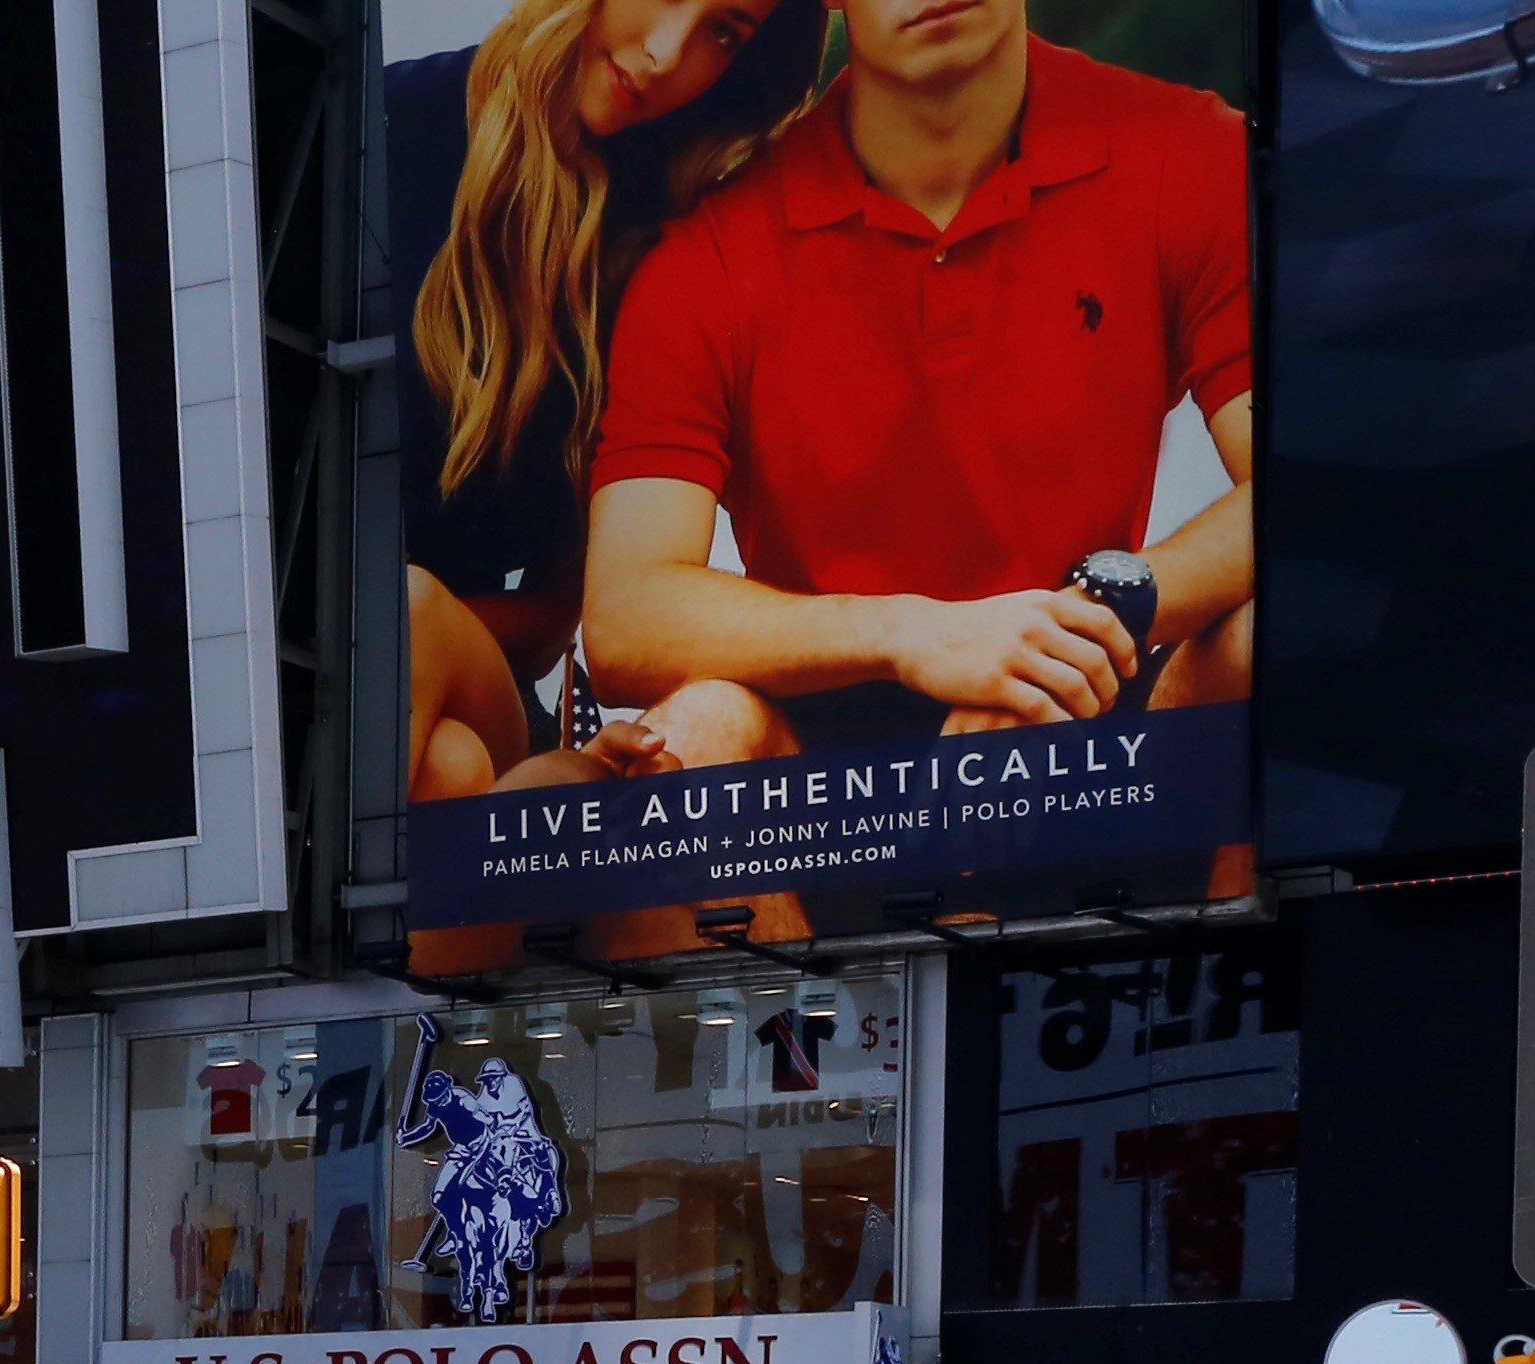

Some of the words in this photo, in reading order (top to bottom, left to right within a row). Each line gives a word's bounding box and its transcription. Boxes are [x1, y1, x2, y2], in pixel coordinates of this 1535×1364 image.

[483, 853, 570, 877] PAMELA
[581, 836, 709, 868] FLANAGAN
[745, 821, 829, 848] JONNY
[841, 809, 931, 837] LAVINE
[962, 798, 1031, 823] POLO
[1044, 783, 1156, 813] PLAYERS
[488, 801, 602, 843] LIVE
[641, 733, 1147, 827] AUTHENTICALLY
[710, 845, 897, 880] USPOLOASSN.COM
